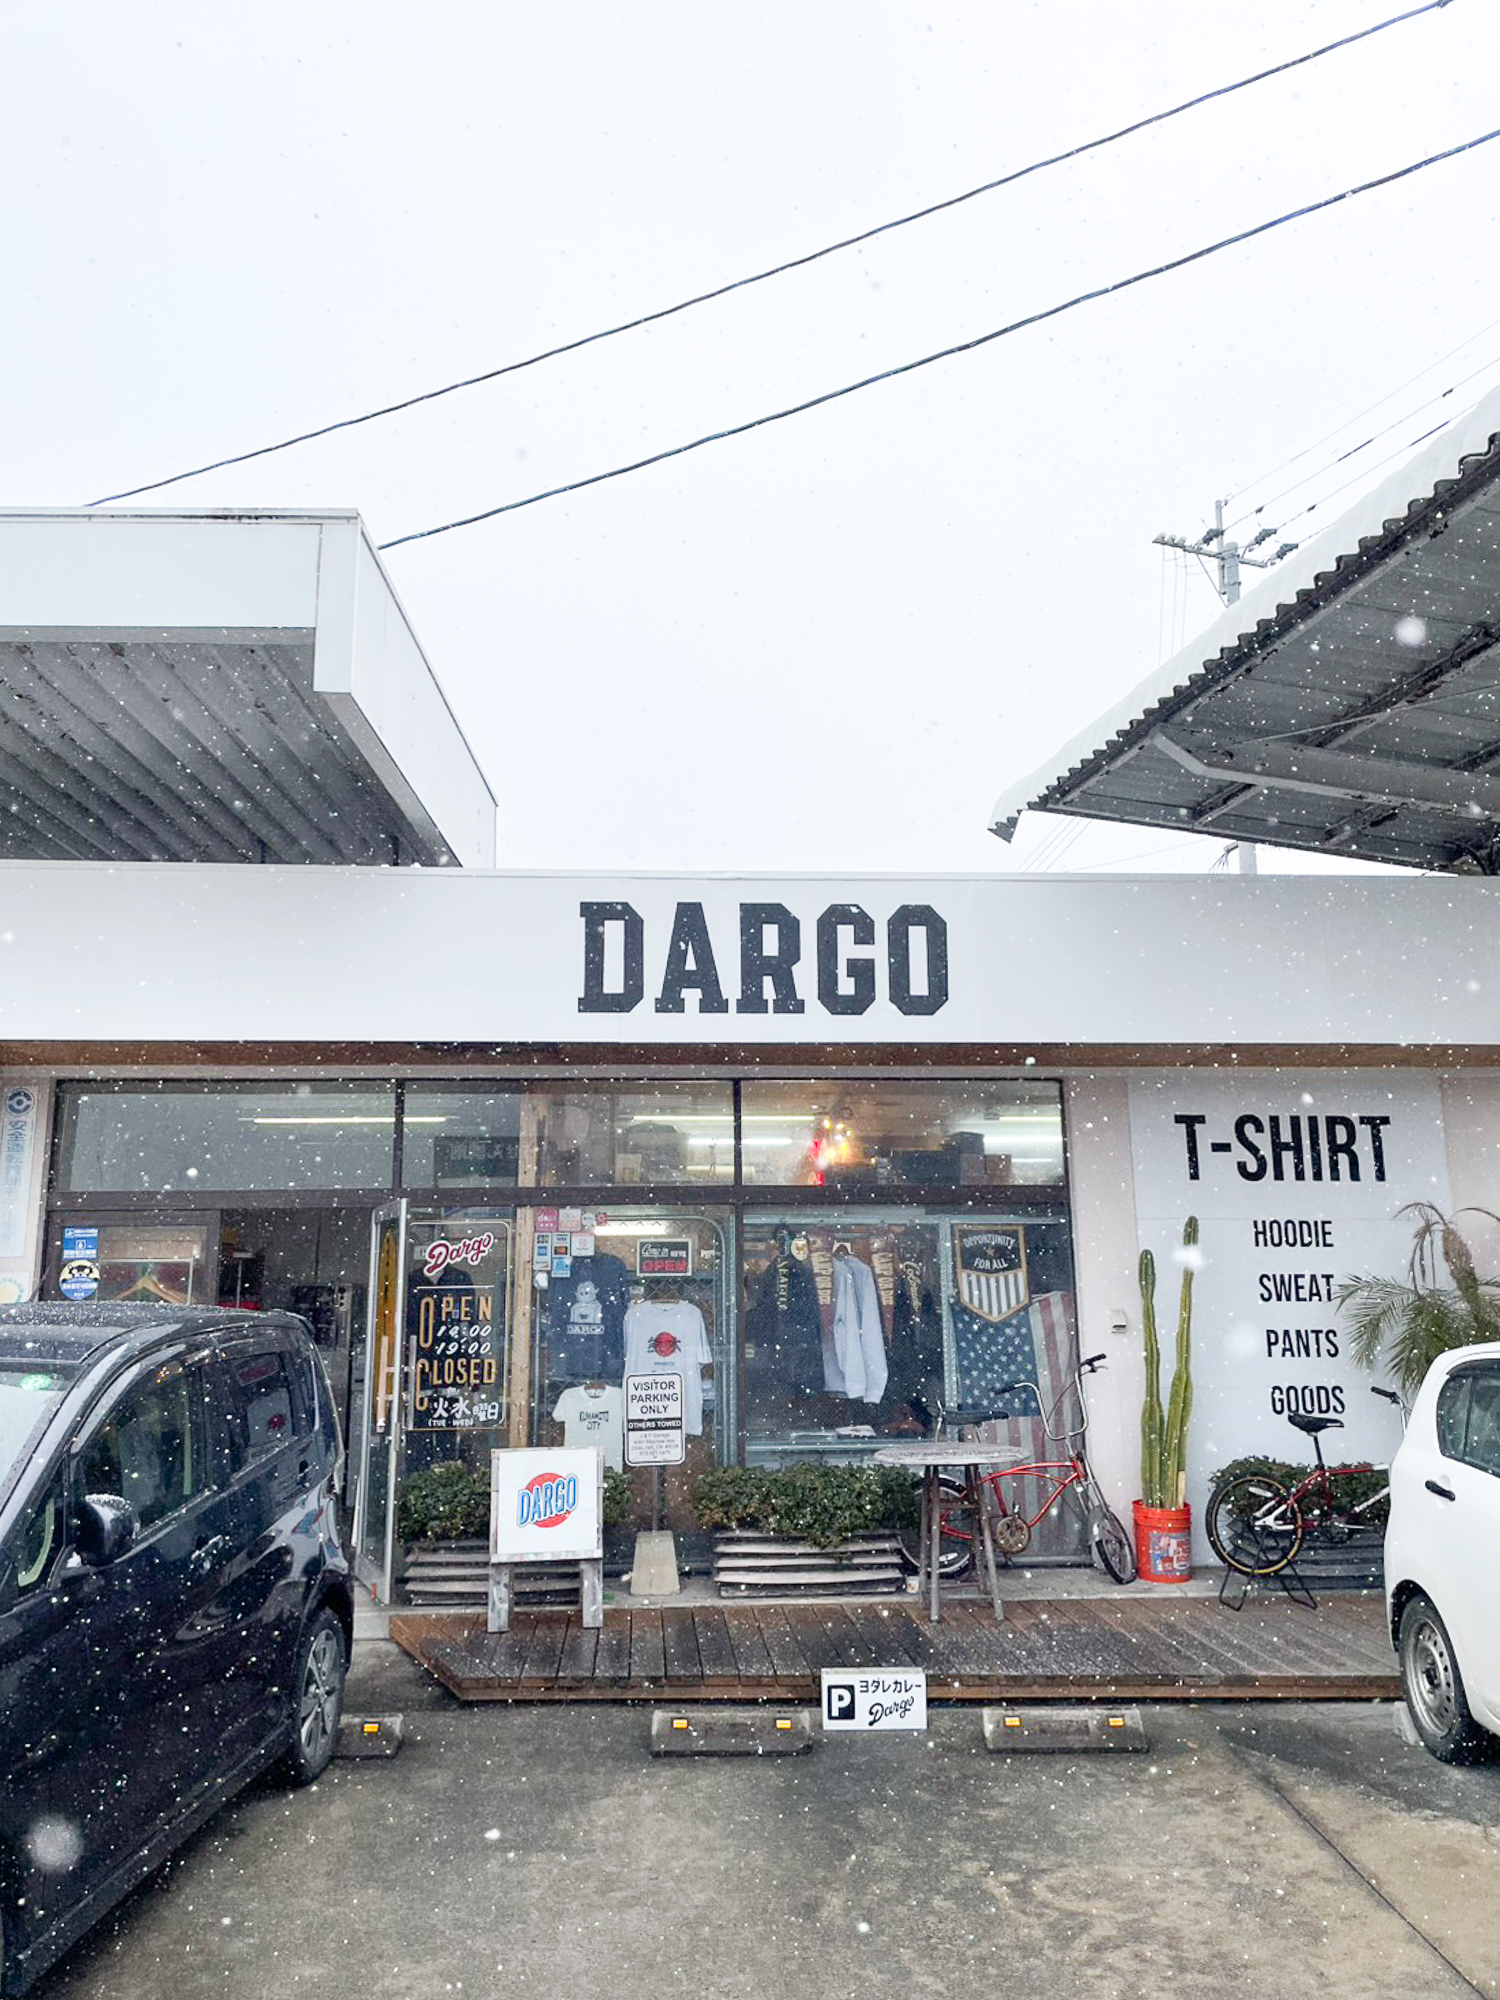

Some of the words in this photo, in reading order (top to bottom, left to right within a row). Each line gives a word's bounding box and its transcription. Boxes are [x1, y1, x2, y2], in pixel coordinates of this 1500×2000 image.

[577, 901, 949, 1016] DARGO
[1174, 1114, 1391, 1182] T-SHIRT
[963, 1234, 1016, 1249] OPPORTUNITY
[1253, 1219, 1334, 1248] HOODIE
[423, 1232, 494, 1276] Dargo
[974, 1258, 991, 1269] FOR
[992, 1258, 1008, 1269] ALL
[1258, 1273, 1335, 1302] SWEAT
[420, 1295, 493, 1349] OPEN
[436, 1325, 492, 1338] 14:00
[566, 1324, 605, 1335] DARGO
[436, 1341, 491, 1355] 19:00
[1266, 1329, 1340, 1358] PANTS
[415, 1358, 497, 1412] CLOSED
[630, 1393, 679, 1403] PARKING
[633, 1381, 676, 1391] VISITOR
[640, 1404, 669, 1414] ONLY
[1271, 1385, 1346, 1415] GOODS
[628, 1421, 656, 1429] OTHERS
[657, 1420, 681, 1428] TOWED
[517, 1475, 578, 1527] DARGO
[859, 1679, 922, 1694] ヨダレカレー
[831, 1688, 852, 1718] P
[868, 1696, 915, 1727] Dargo
